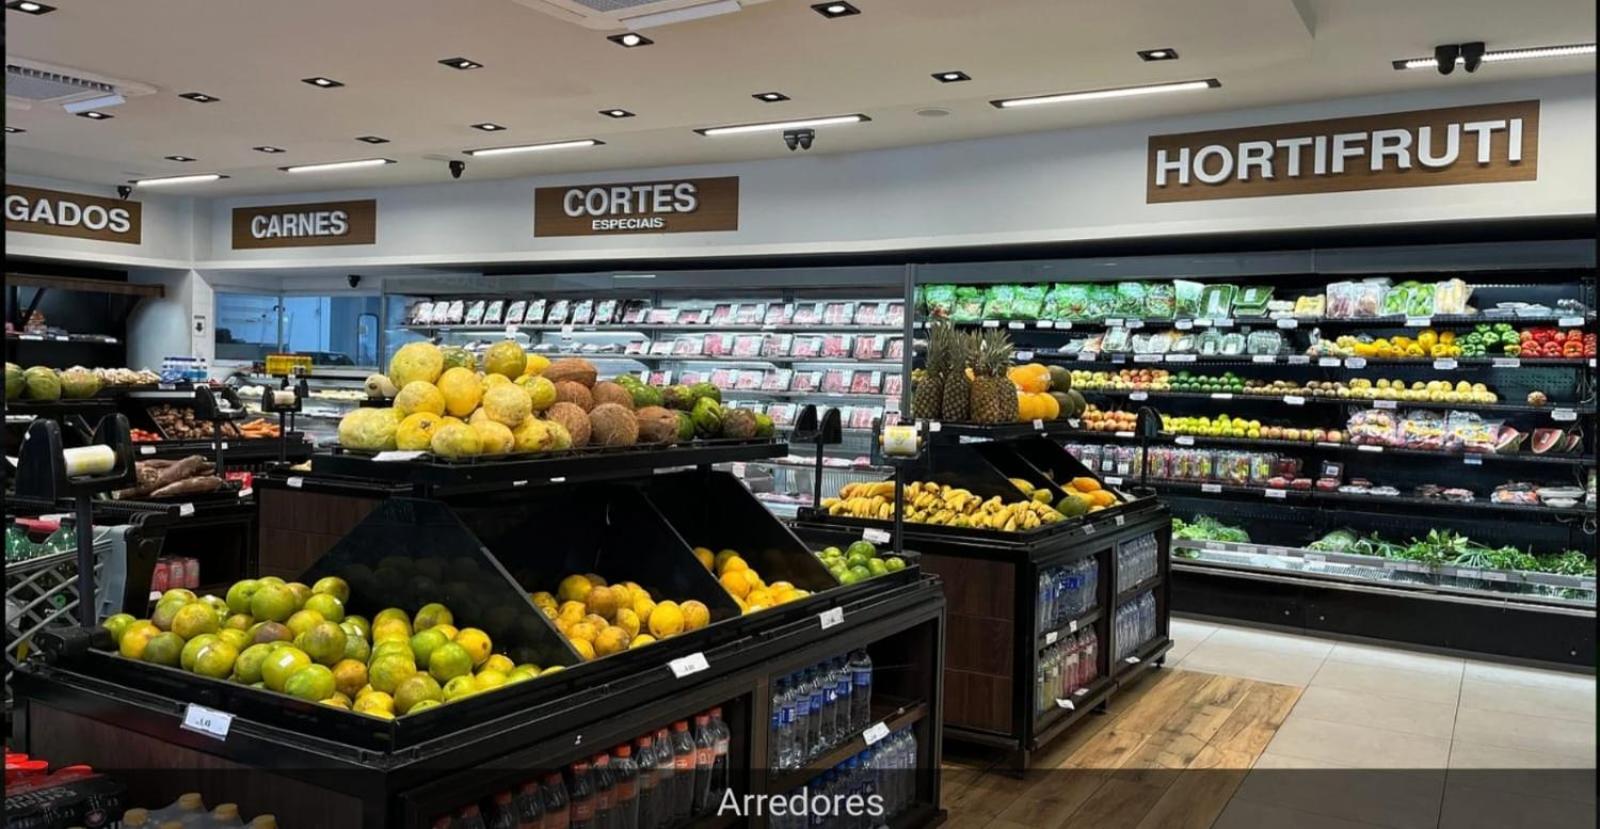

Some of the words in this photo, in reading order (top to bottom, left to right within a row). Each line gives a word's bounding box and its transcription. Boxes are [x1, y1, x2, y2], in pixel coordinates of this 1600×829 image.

[1155, 118, 1523, 187] HORTIFRUTI
[5, 194, 131, 233] GADOS
[563, 183, 698, 217] CORTES
[251, 210, 348, 239] CARNES
[592, 217, 665, 231] ESPECIAIS
